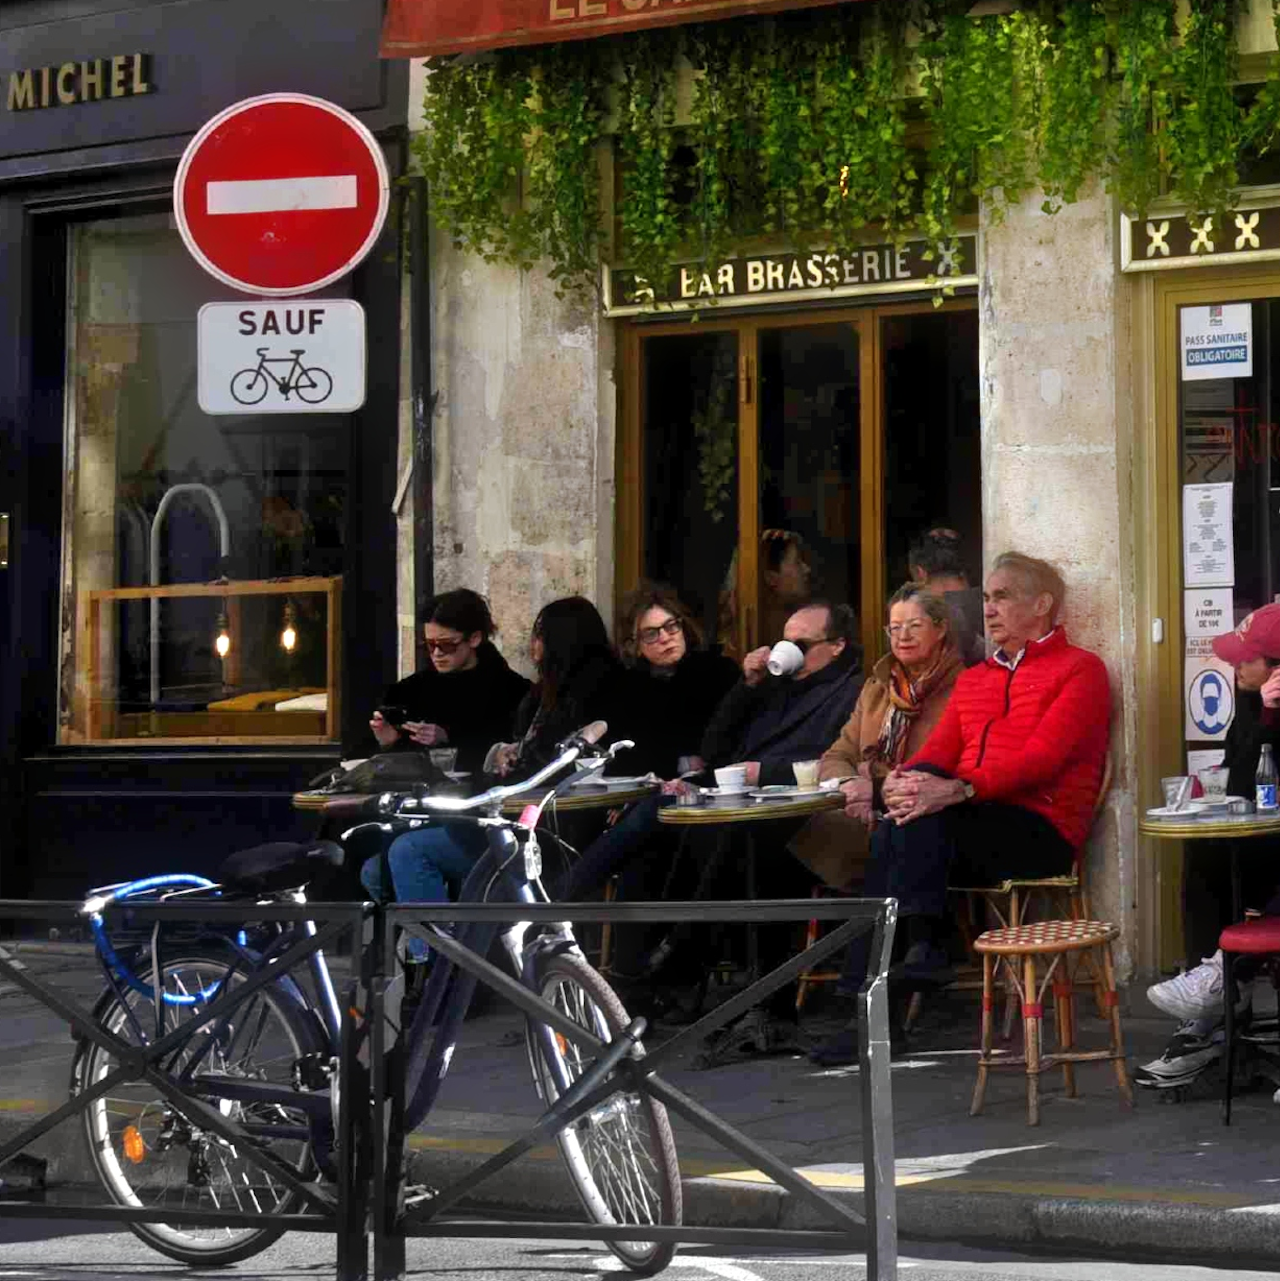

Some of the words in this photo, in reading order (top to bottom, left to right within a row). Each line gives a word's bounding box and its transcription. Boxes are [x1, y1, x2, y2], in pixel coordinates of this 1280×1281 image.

[6, 52, 149, 112] MICHEL
[747, 247, 912, 294] BRASSERIE
[239, 309, 325, 336] SAUF
[1186, 334, 1205, 346] PASS
[1206, 332, 1247, 345] SANITAIRE
[1188, 348, 1245, 363] OBLIGATOIRE
